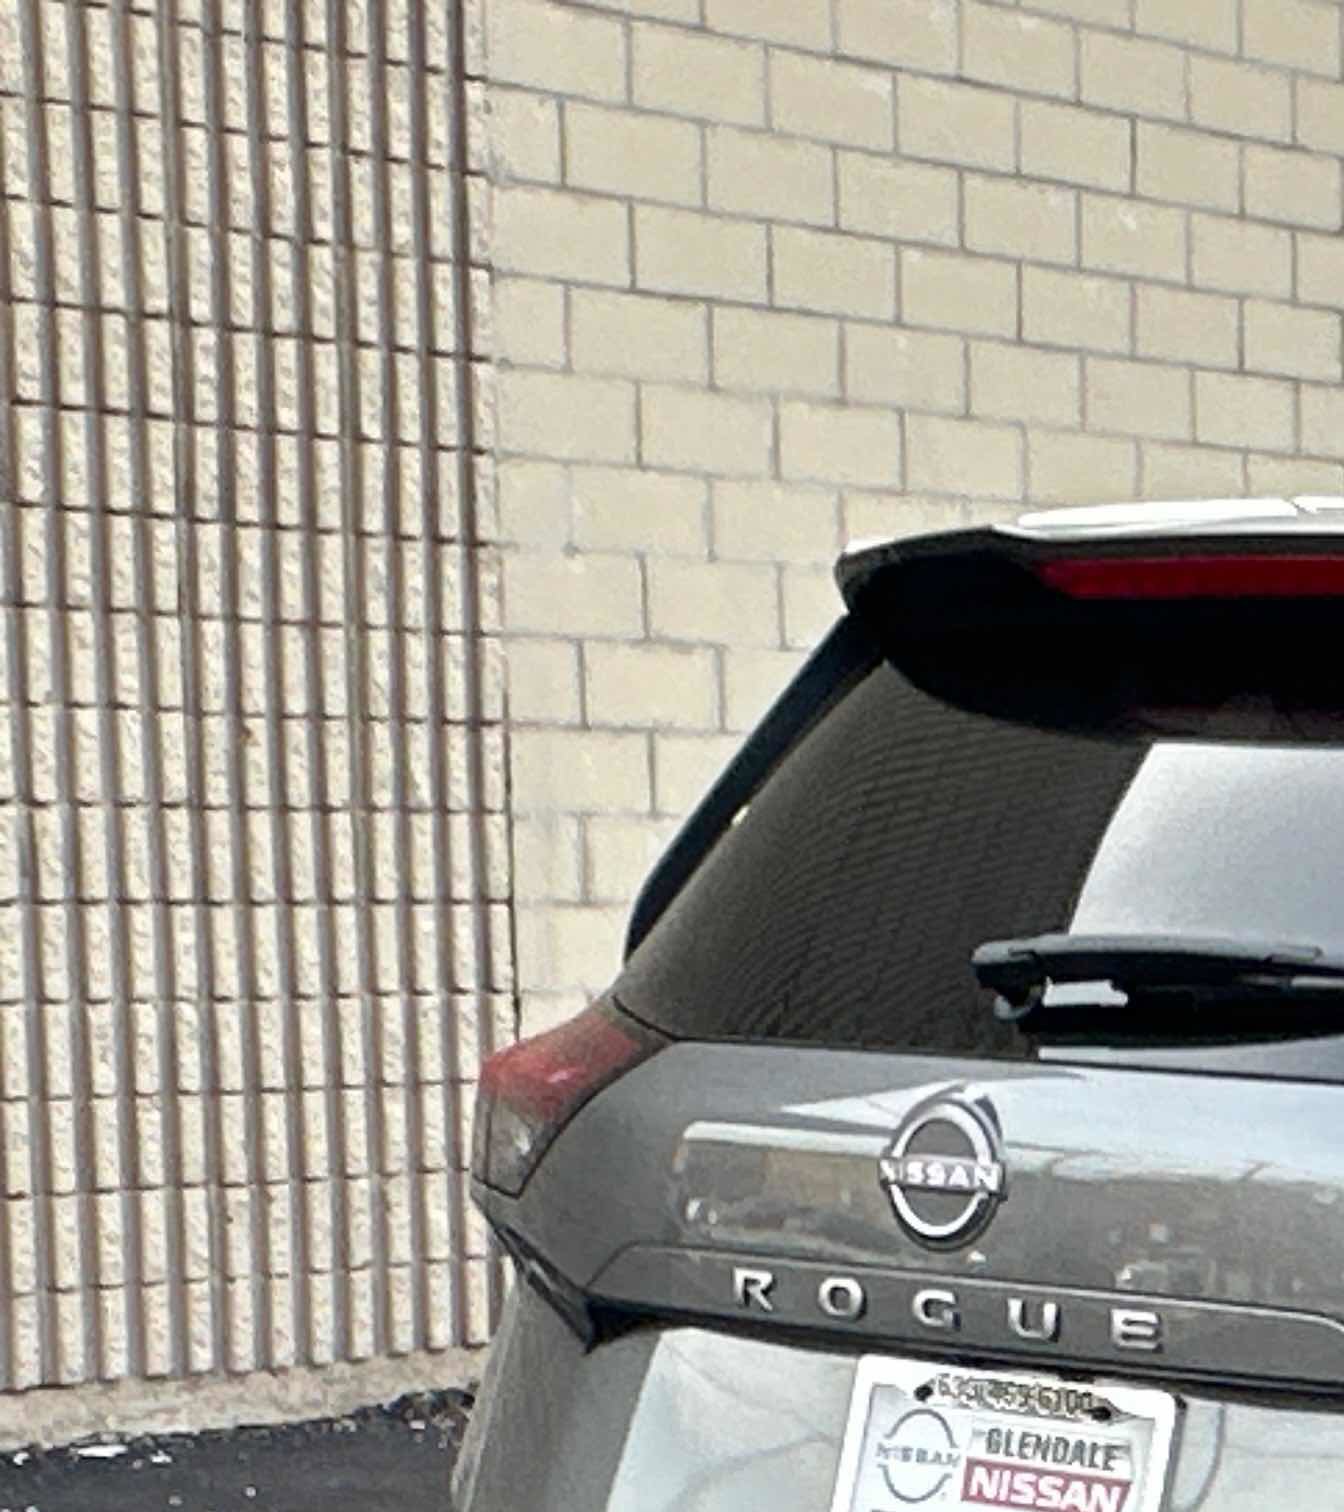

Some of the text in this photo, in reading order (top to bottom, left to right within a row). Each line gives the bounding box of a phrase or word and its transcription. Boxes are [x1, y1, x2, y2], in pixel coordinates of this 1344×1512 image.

[880, 1158, 1000, 1192] NISSAN
[733, 1267, 1162, 1352] ROGUE
[986, 1427, 1121, 1471] GLENDALE
